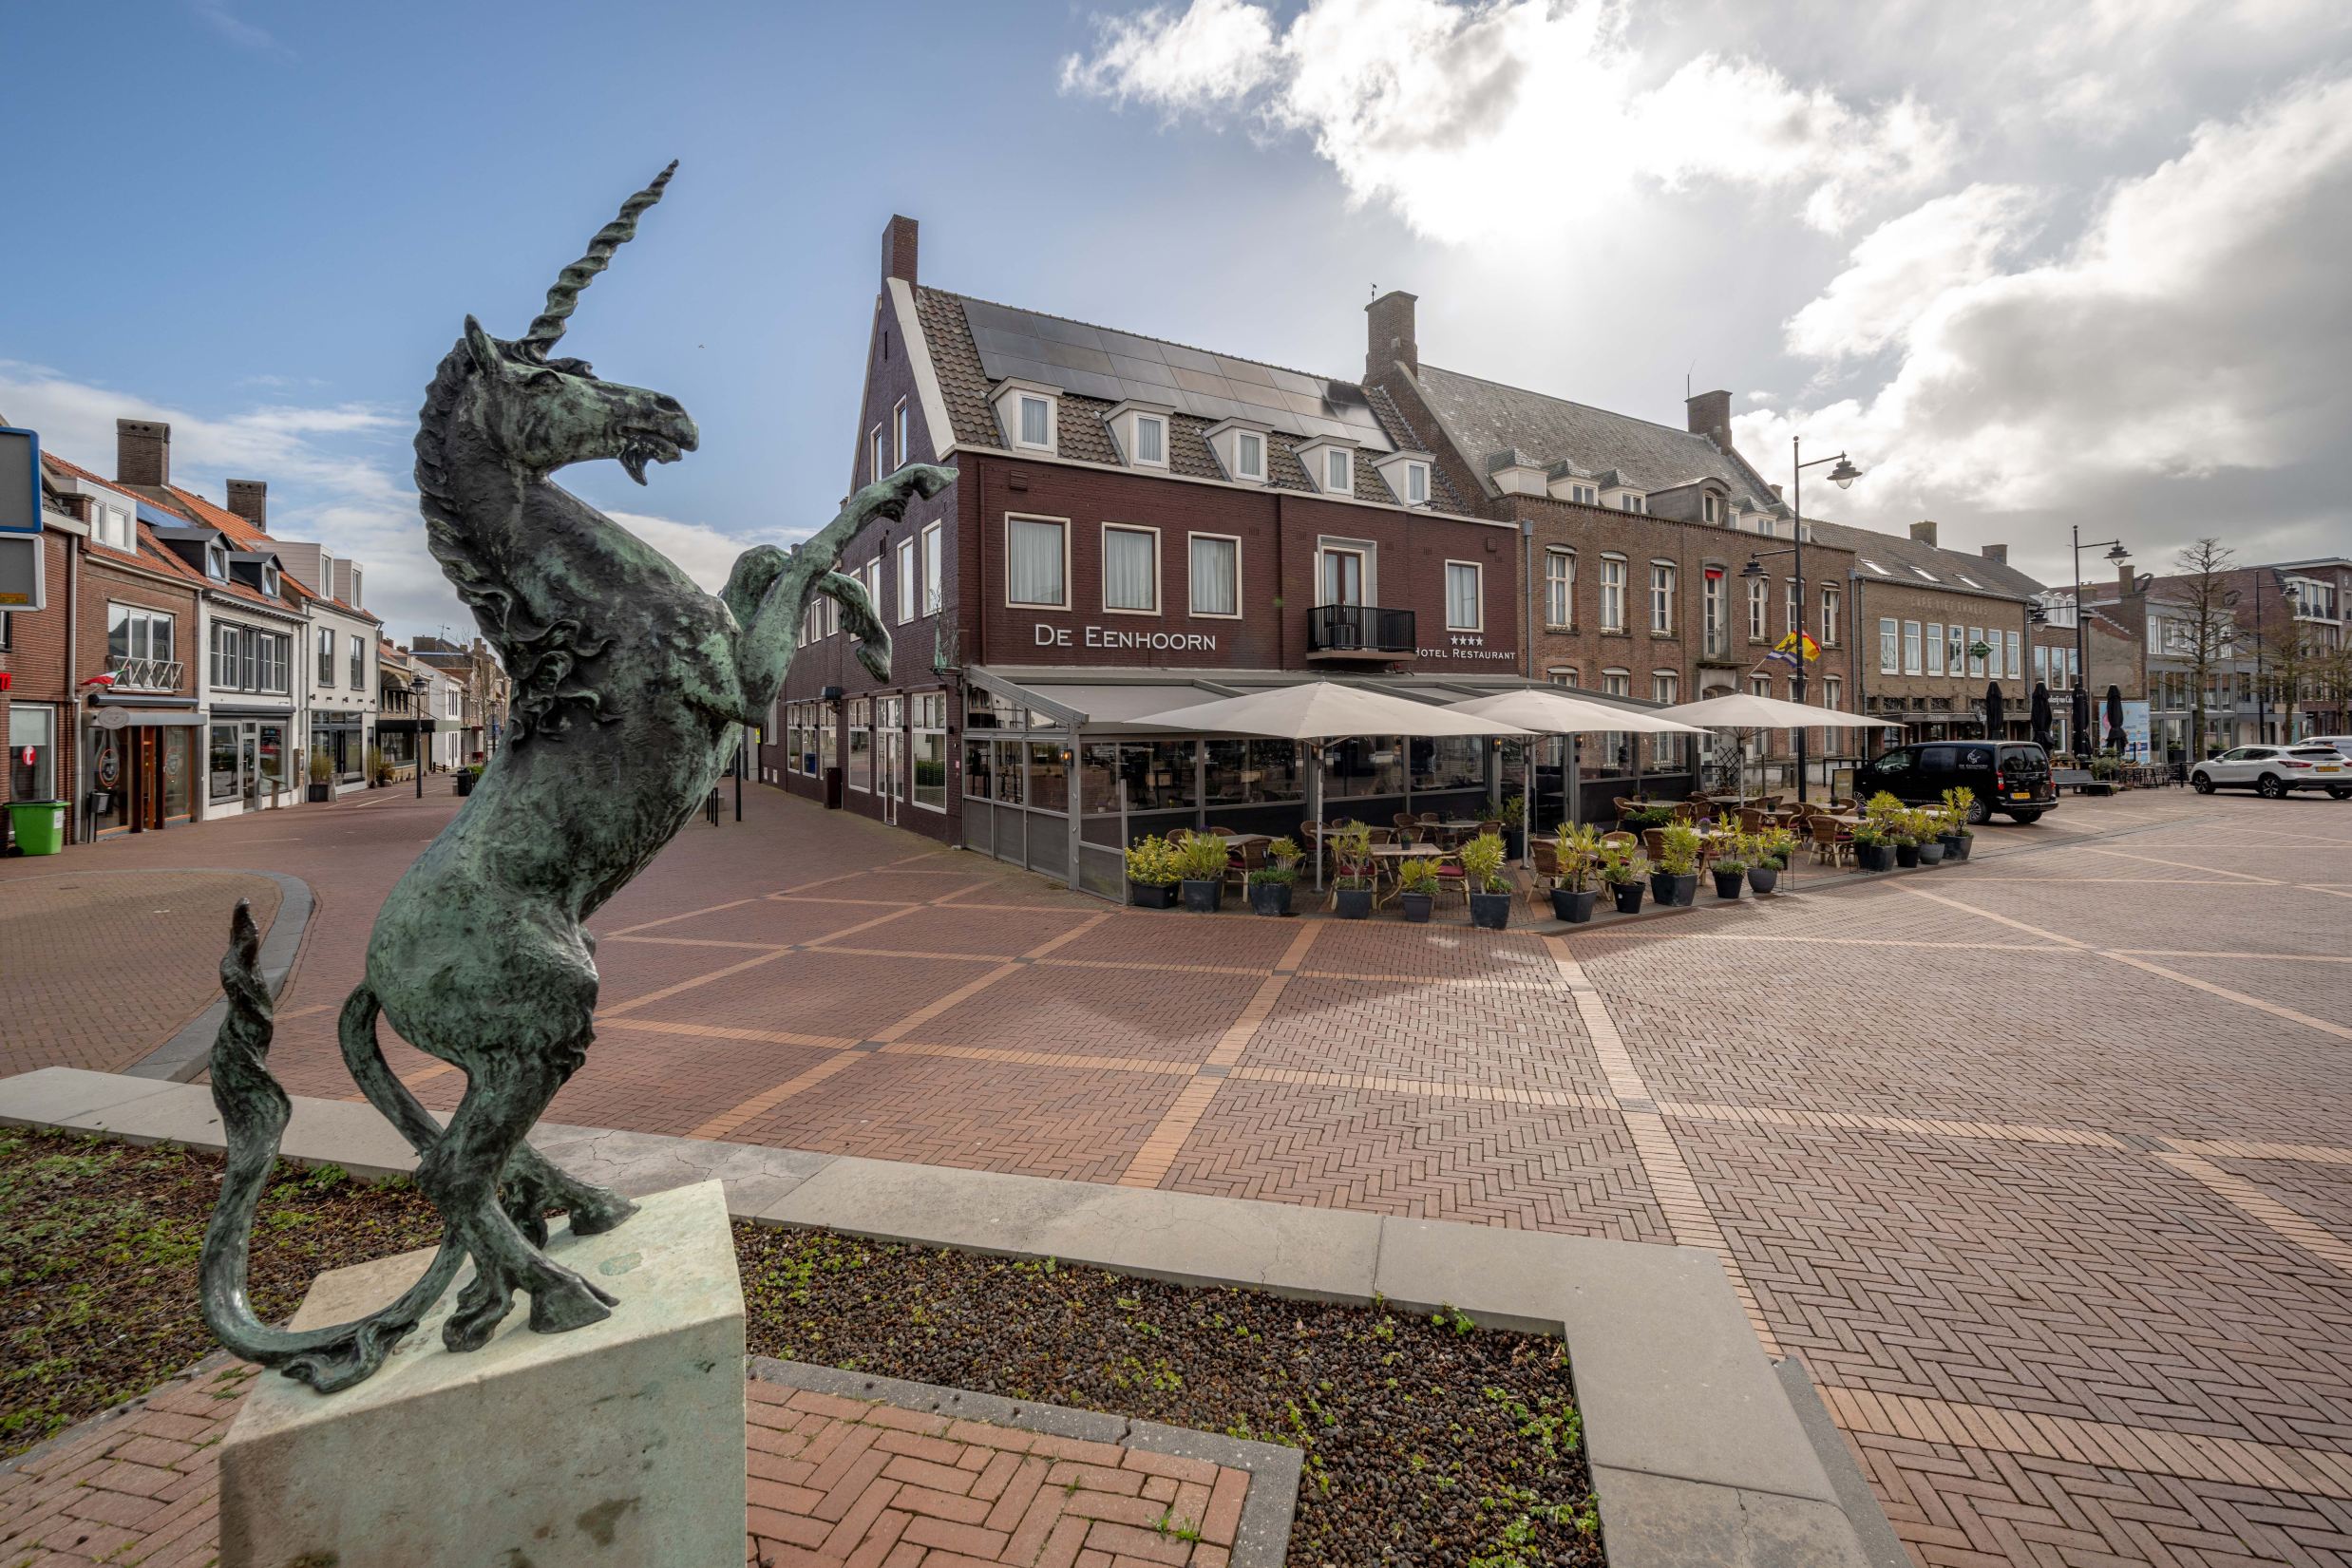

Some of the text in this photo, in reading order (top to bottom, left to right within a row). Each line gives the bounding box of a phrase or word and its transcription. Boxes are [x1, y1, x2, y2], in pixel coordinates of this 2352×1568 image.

[1035, 624, 1216, 651] DE EENHOORN
[1452, 649, 1516, 660] RESTAURANT
